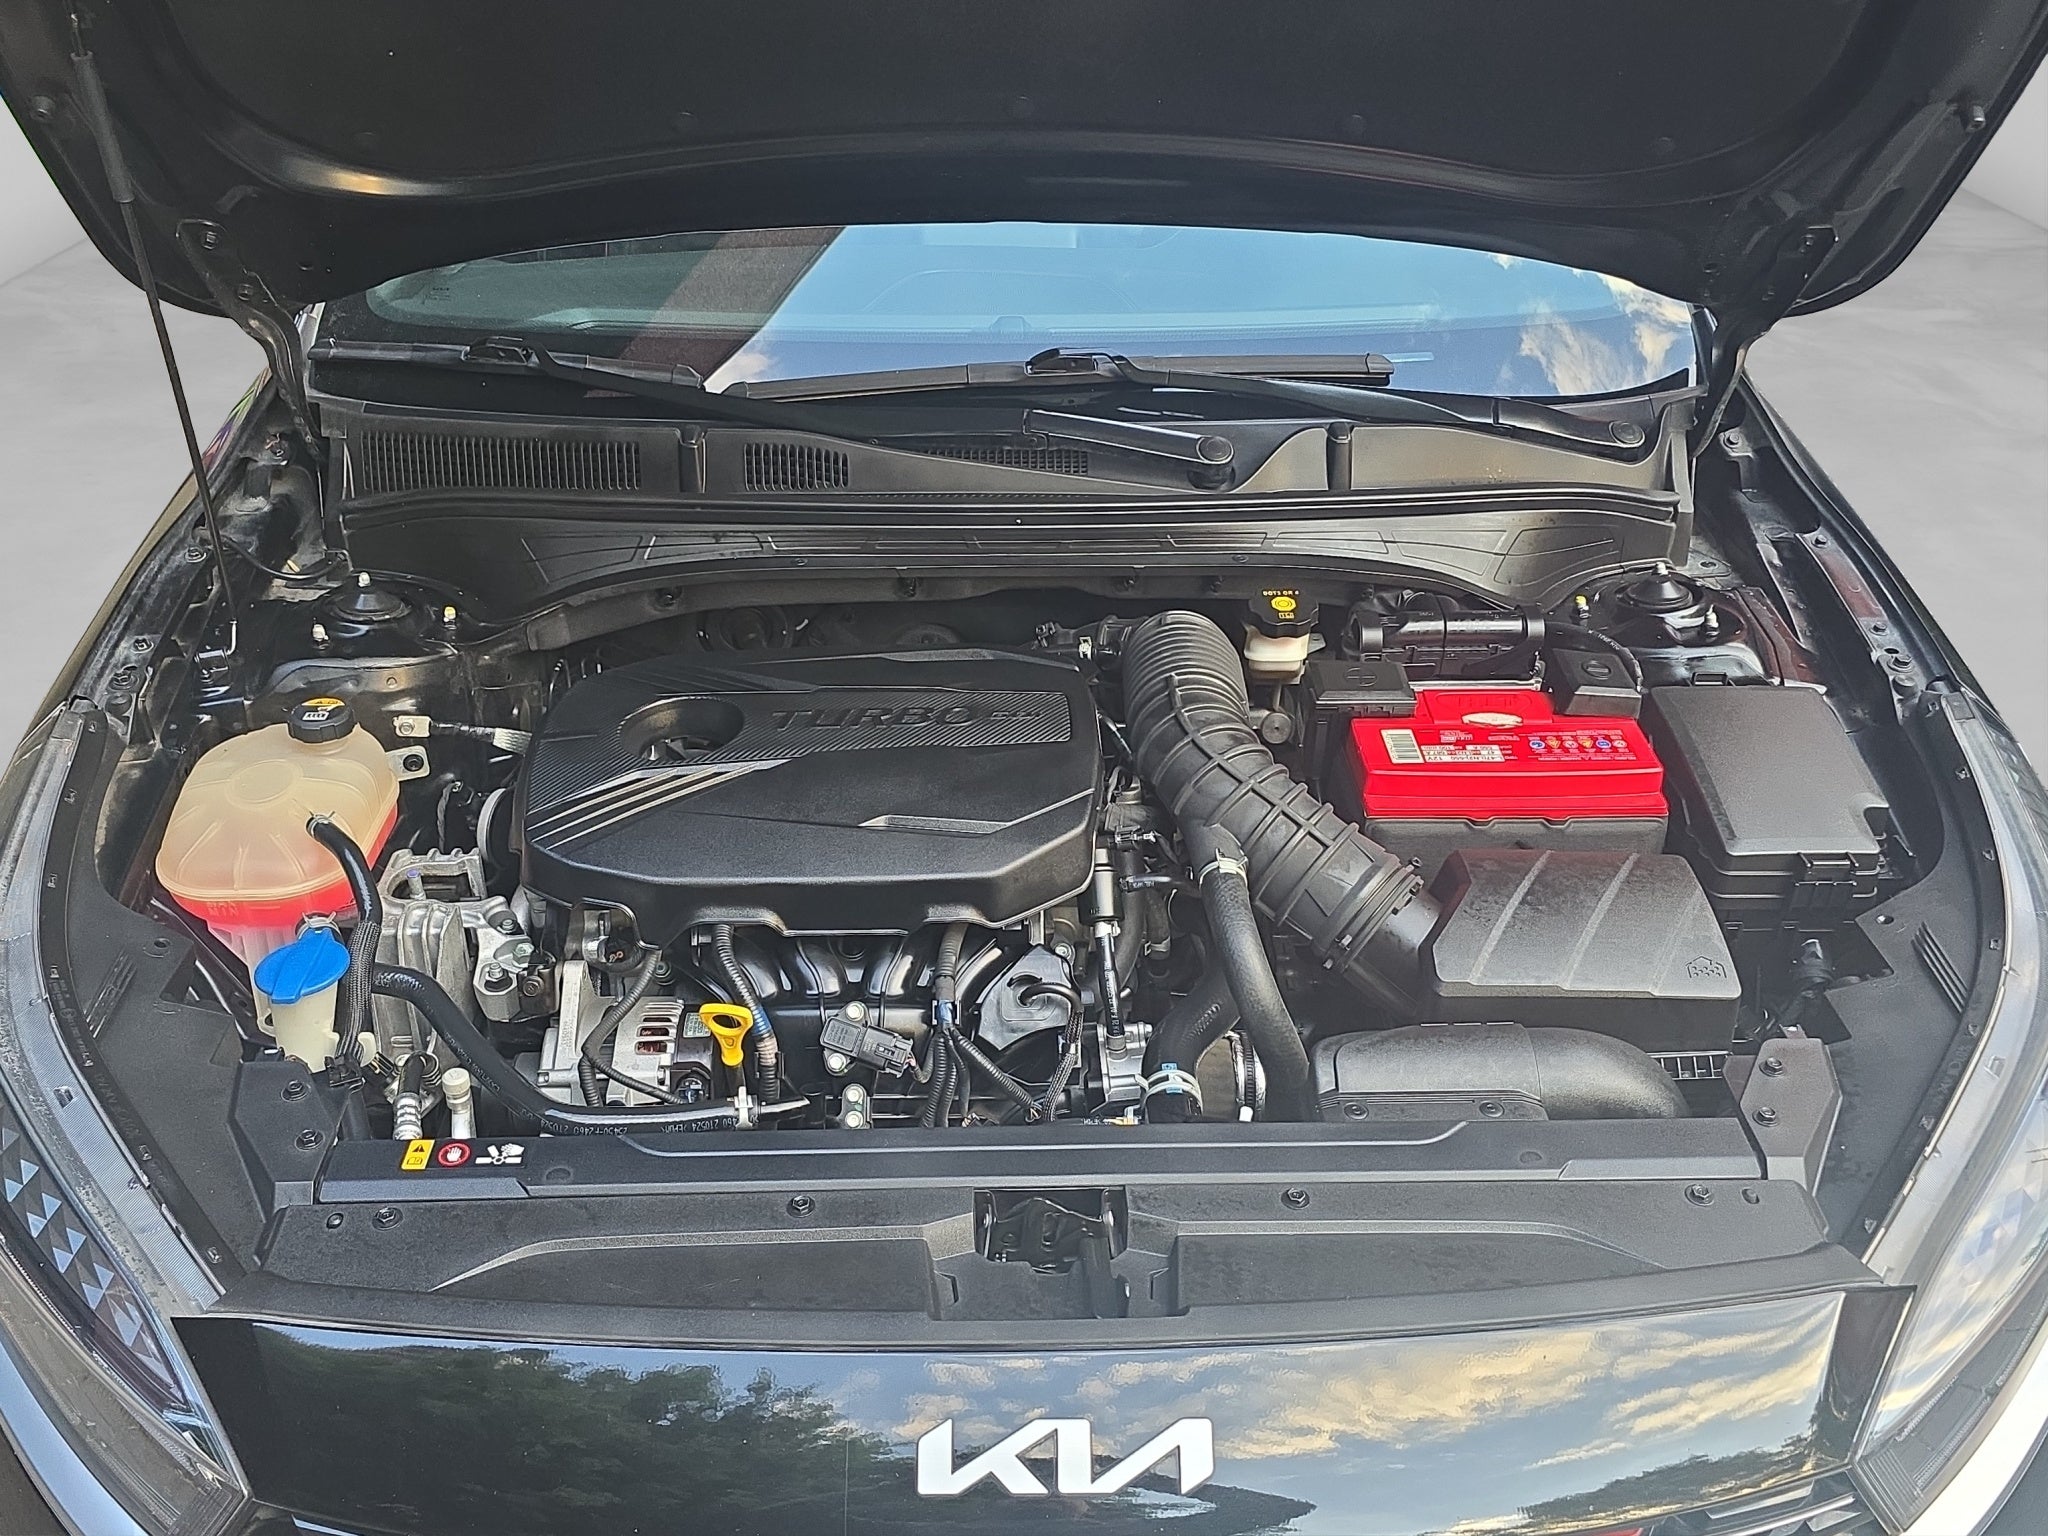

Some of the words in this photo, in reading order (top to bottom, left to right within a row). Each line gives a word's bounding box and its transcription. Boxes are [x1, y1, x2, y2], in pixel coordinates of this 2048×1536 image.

[772, 707, 975, 732] TURBO
[691, 1119, 719, 1131] 210524
[916, 1416, 1214, 1497] KIA
